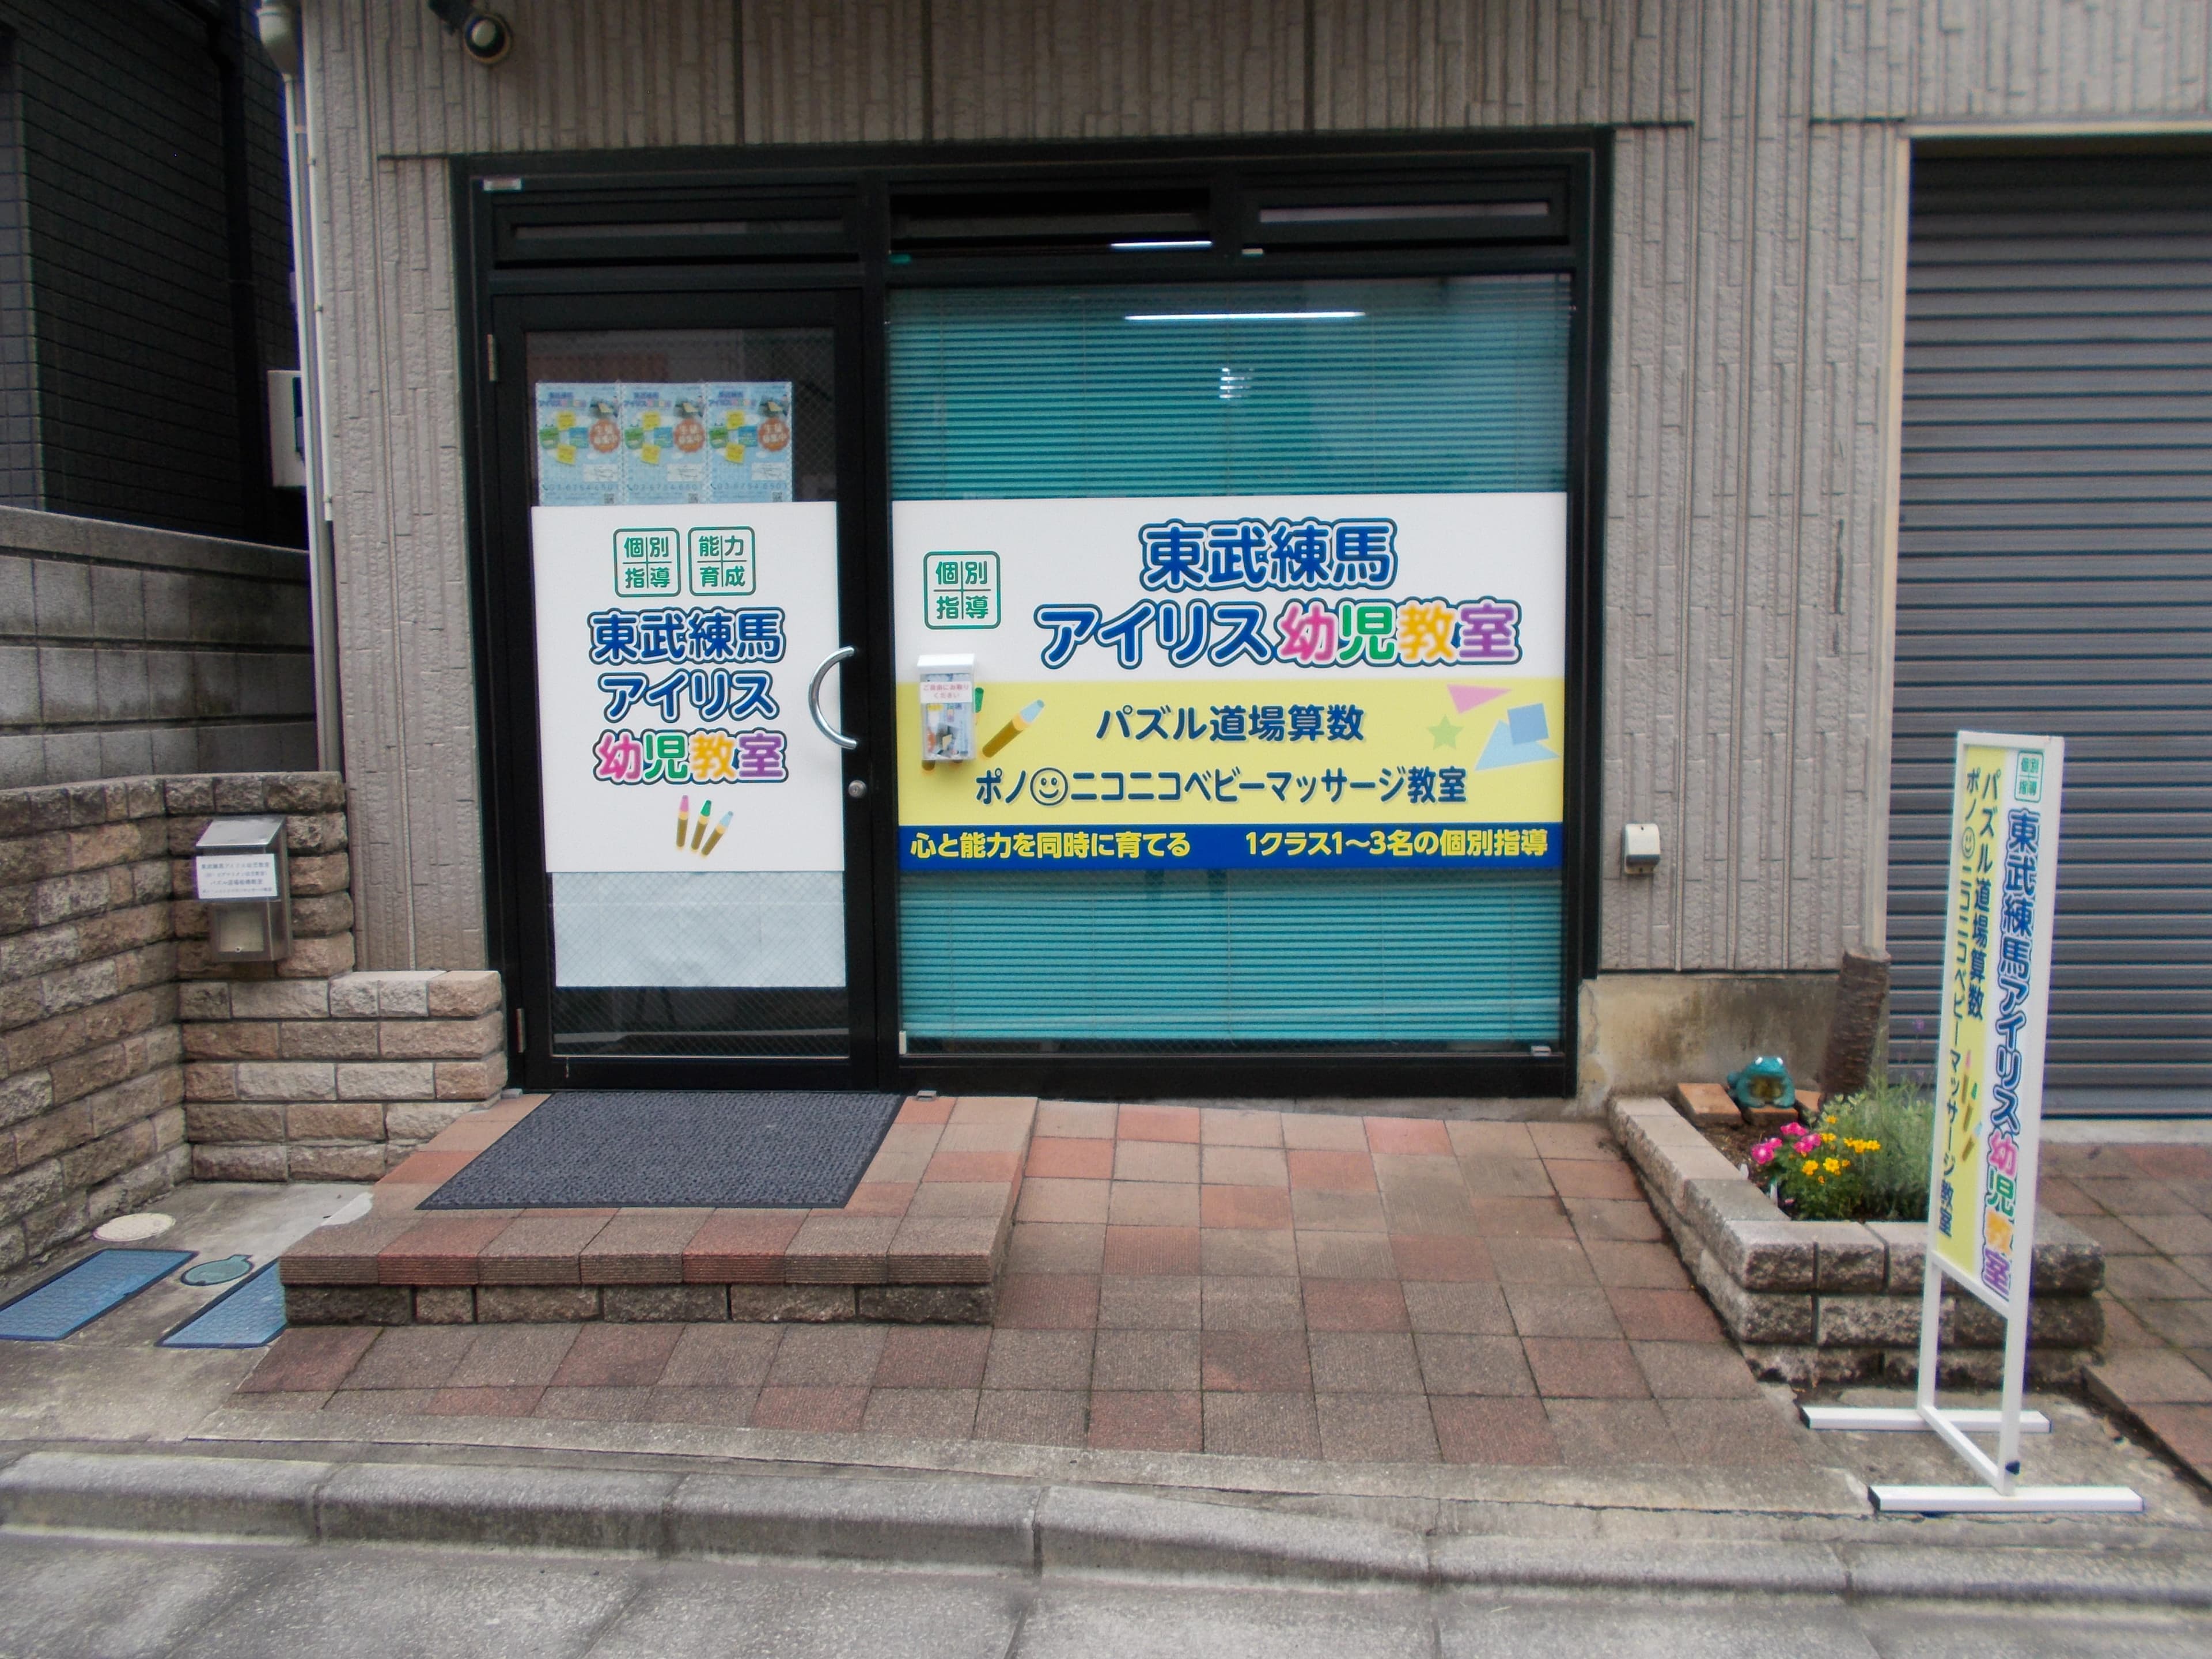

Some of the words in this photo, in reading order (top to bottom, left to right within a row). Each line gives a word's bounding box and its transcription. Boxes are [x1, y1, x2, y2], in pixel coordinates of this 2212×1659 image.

[624, 536, 669, 558] 個別
[698, 535, 744, 557] 能力
[1138, 516, 1398, 593] 東武練馬
[624, 566, 671, 590] 指導
[699, 565, 745, 588] 育成
[935, 560, 988, 585] 個別
[936, 595, 989, 620] 指導
[588, 606, 786, 665] 東武練馬
[1033, 596, 1522, 669] アイリス幼児教室
[598, 668, 779, 724] アイリス
[1096, 704, 1365, 742] パズル道場算数
[593, 727, 788, 785] 幼児教室
[910, 832, 1191, 858] 心と能力を同時に育てる
[1968, 768, 2001, 1020] パズル道場算数
